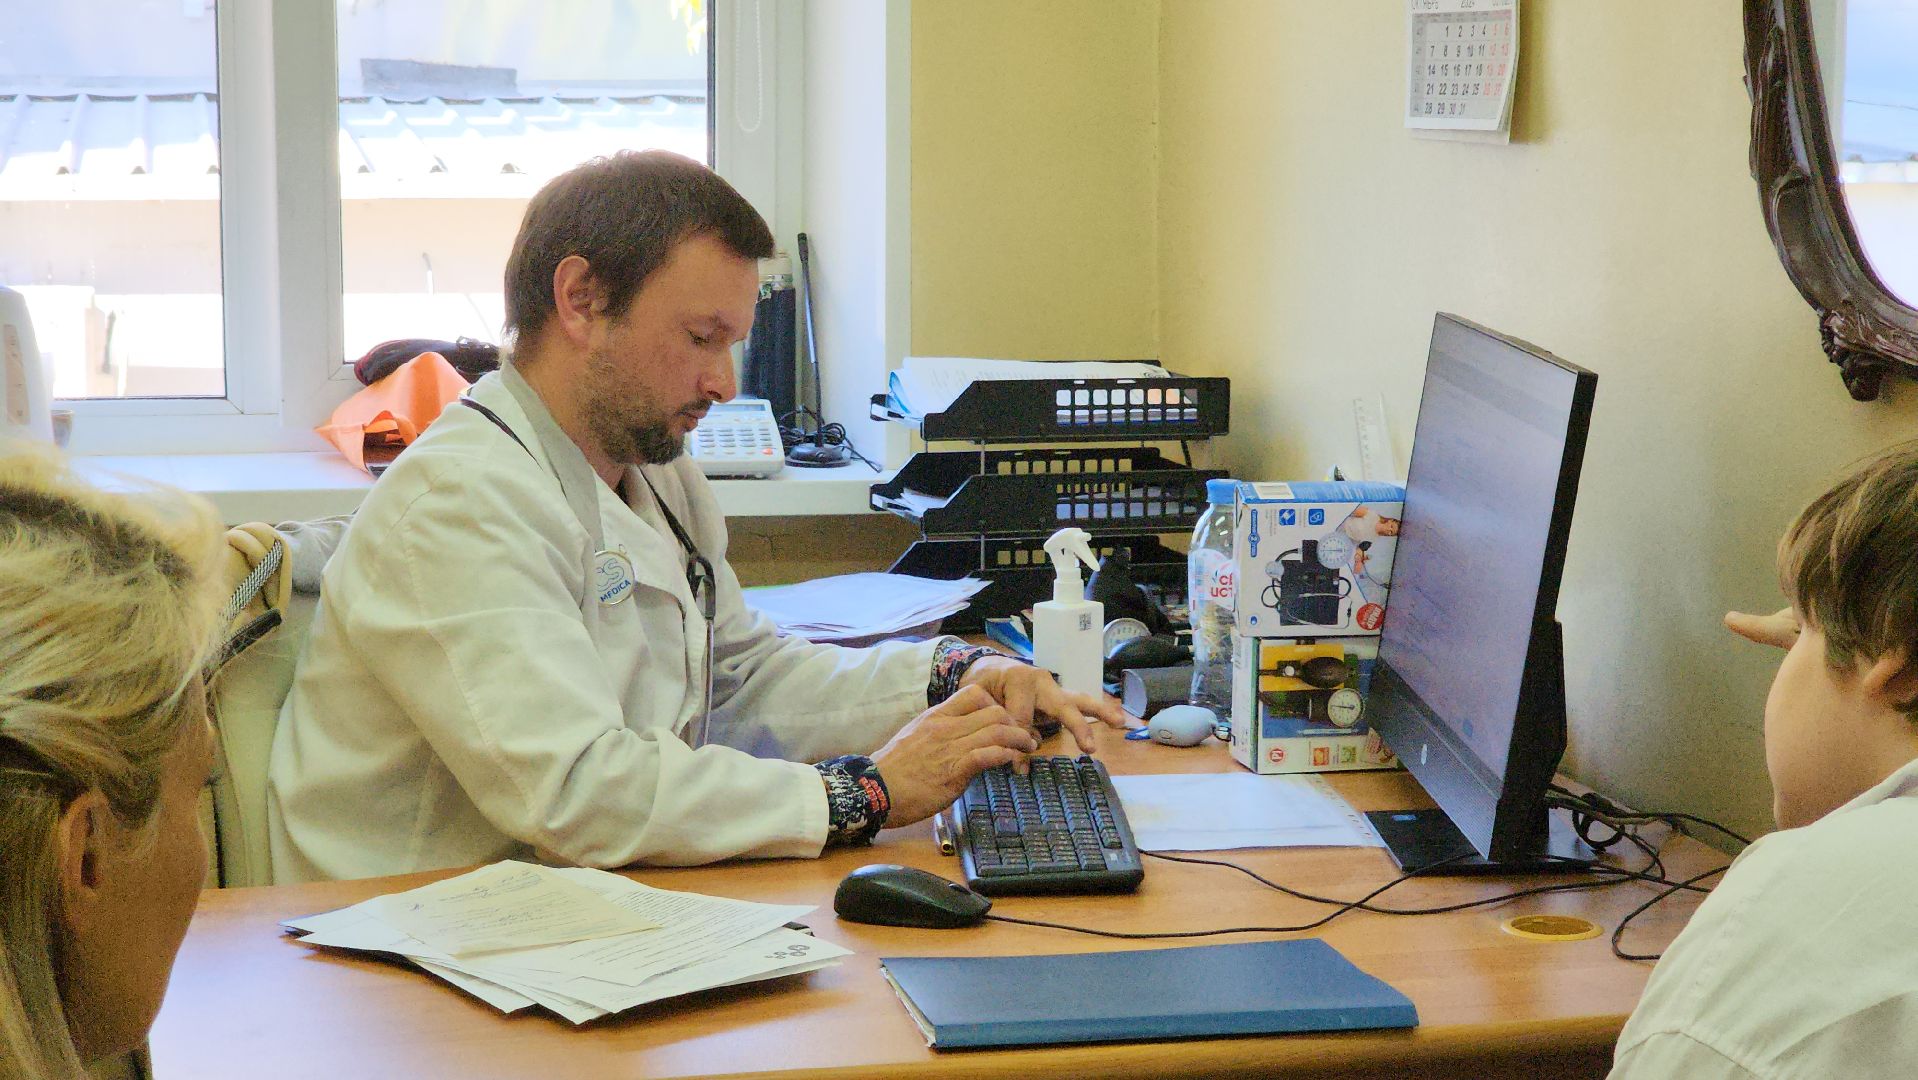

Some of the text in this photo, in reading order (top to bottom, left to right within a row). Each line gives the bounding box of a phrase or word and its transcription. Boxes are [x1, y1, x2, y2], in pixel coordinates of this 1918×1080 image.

[1467, 45, 1474, 57] 10
[1478, 44, 1486, 56] 11
[1428, 64, 1436, 76] 14
[1440, 64, 1448, 76] 15
[1454, 64, 1460, 76] 16
[1465, 64, 1472, 76] 17
[1426, 83, 1434, 96] 21
[1438, 83, 1447, 96] 22
[1451, 83, 1458, 96] 23
[1462, 83, 1470, 96] 24
[1472, 83, 1480, 96] 25
[1425, 102, 1432, 114] 28
[1438, 102, 1445, 114] 29
[600, 580, 631, 602] MEDICA
